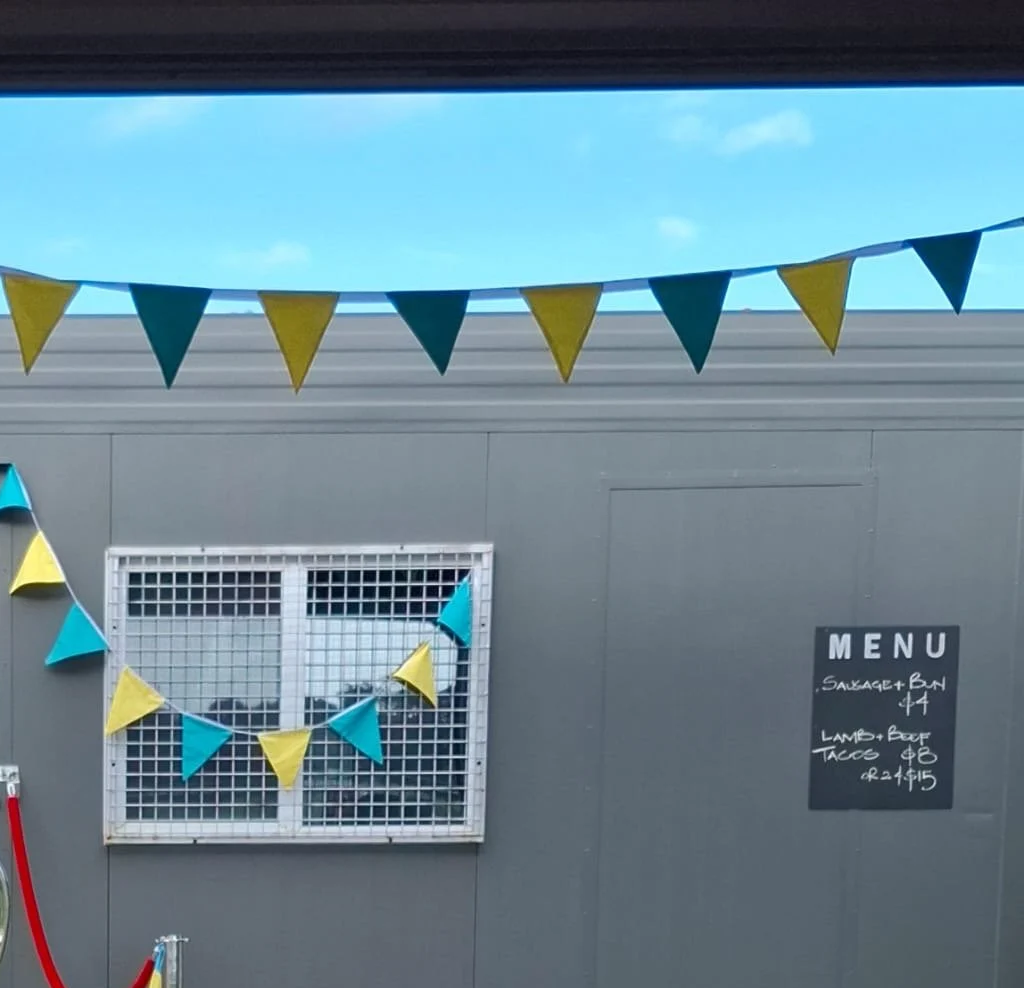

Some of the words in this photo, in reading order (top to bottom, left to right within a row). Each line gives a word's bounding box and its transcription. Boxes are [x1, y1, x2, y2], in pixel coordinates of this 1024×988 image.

[828, 632, 946, 660] MENU
[898, 690, 929, 716] $4
[887, 725, 931, 746] BEEF
[812, 746, 880, 762] TACOS
